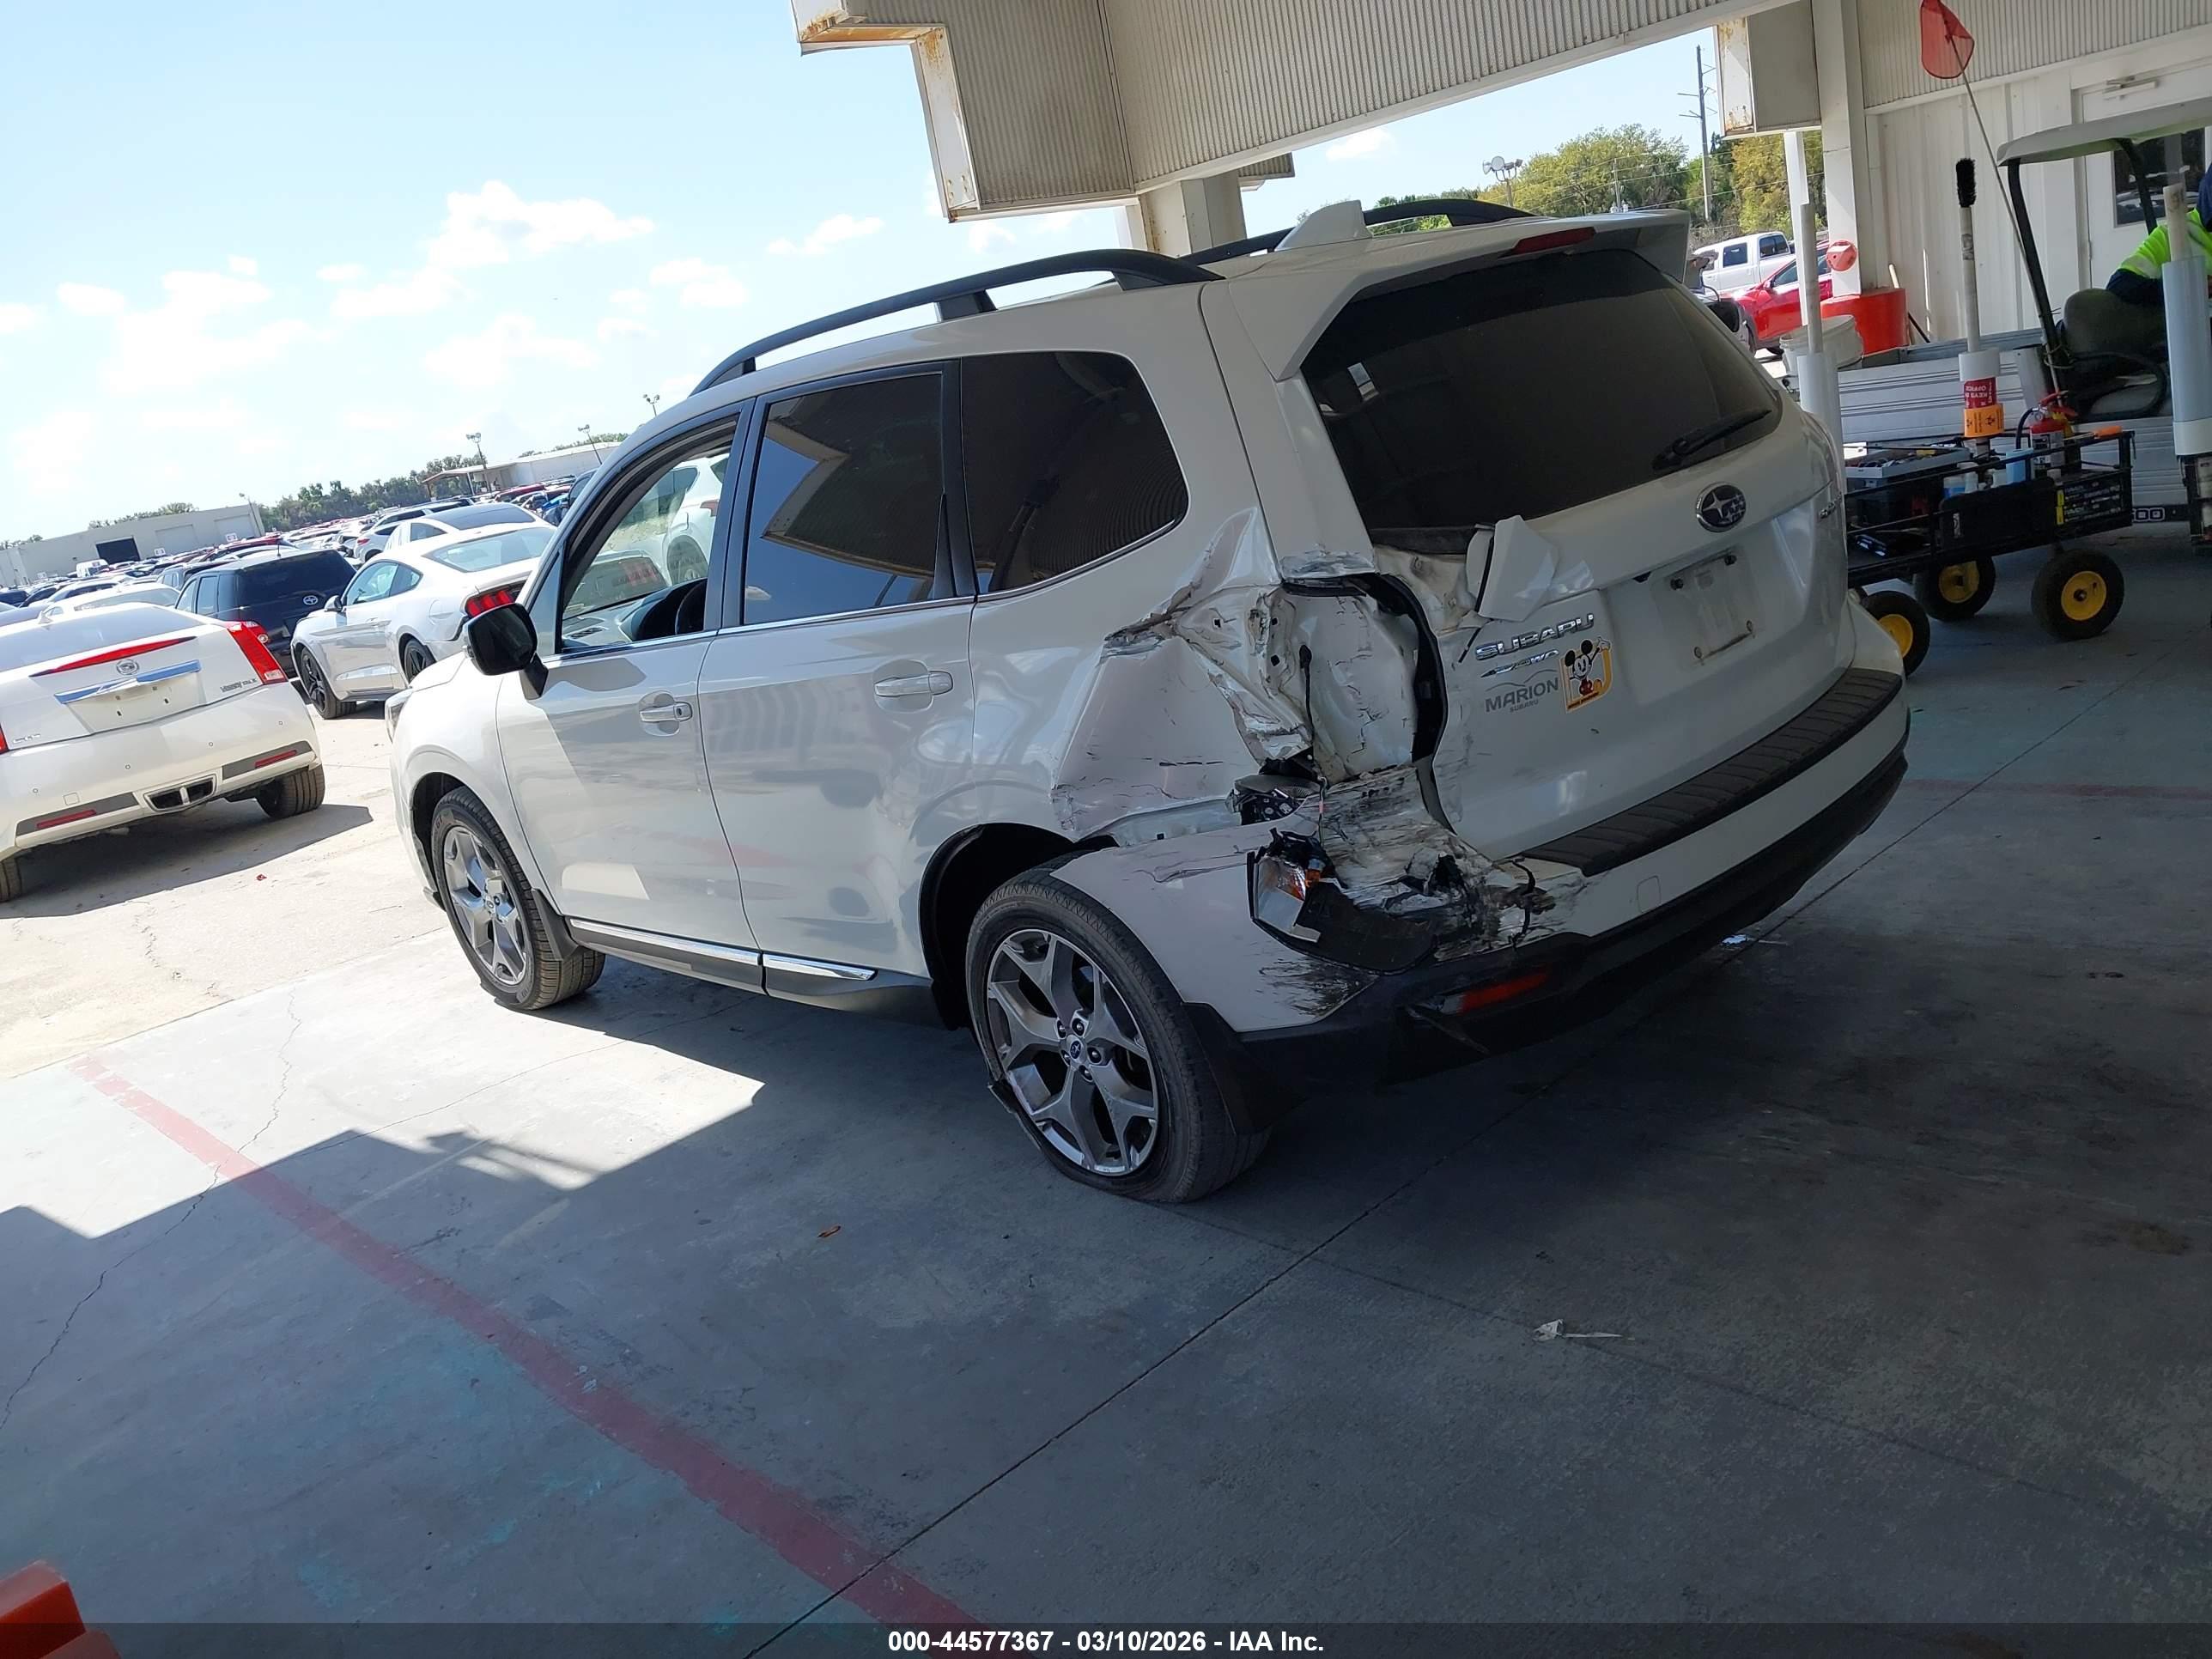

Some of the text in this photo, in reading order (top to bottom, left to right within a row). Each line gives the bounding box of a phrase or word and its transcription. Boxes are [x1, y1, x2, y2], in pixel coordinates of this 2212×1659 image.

[2131, 507, 2166, 522] 00
[1475, 612, 1595, 661] SUBARU
[1486, 677, 1559, 713] MARION
[1510, 698, 1539, 713] SUBARU
